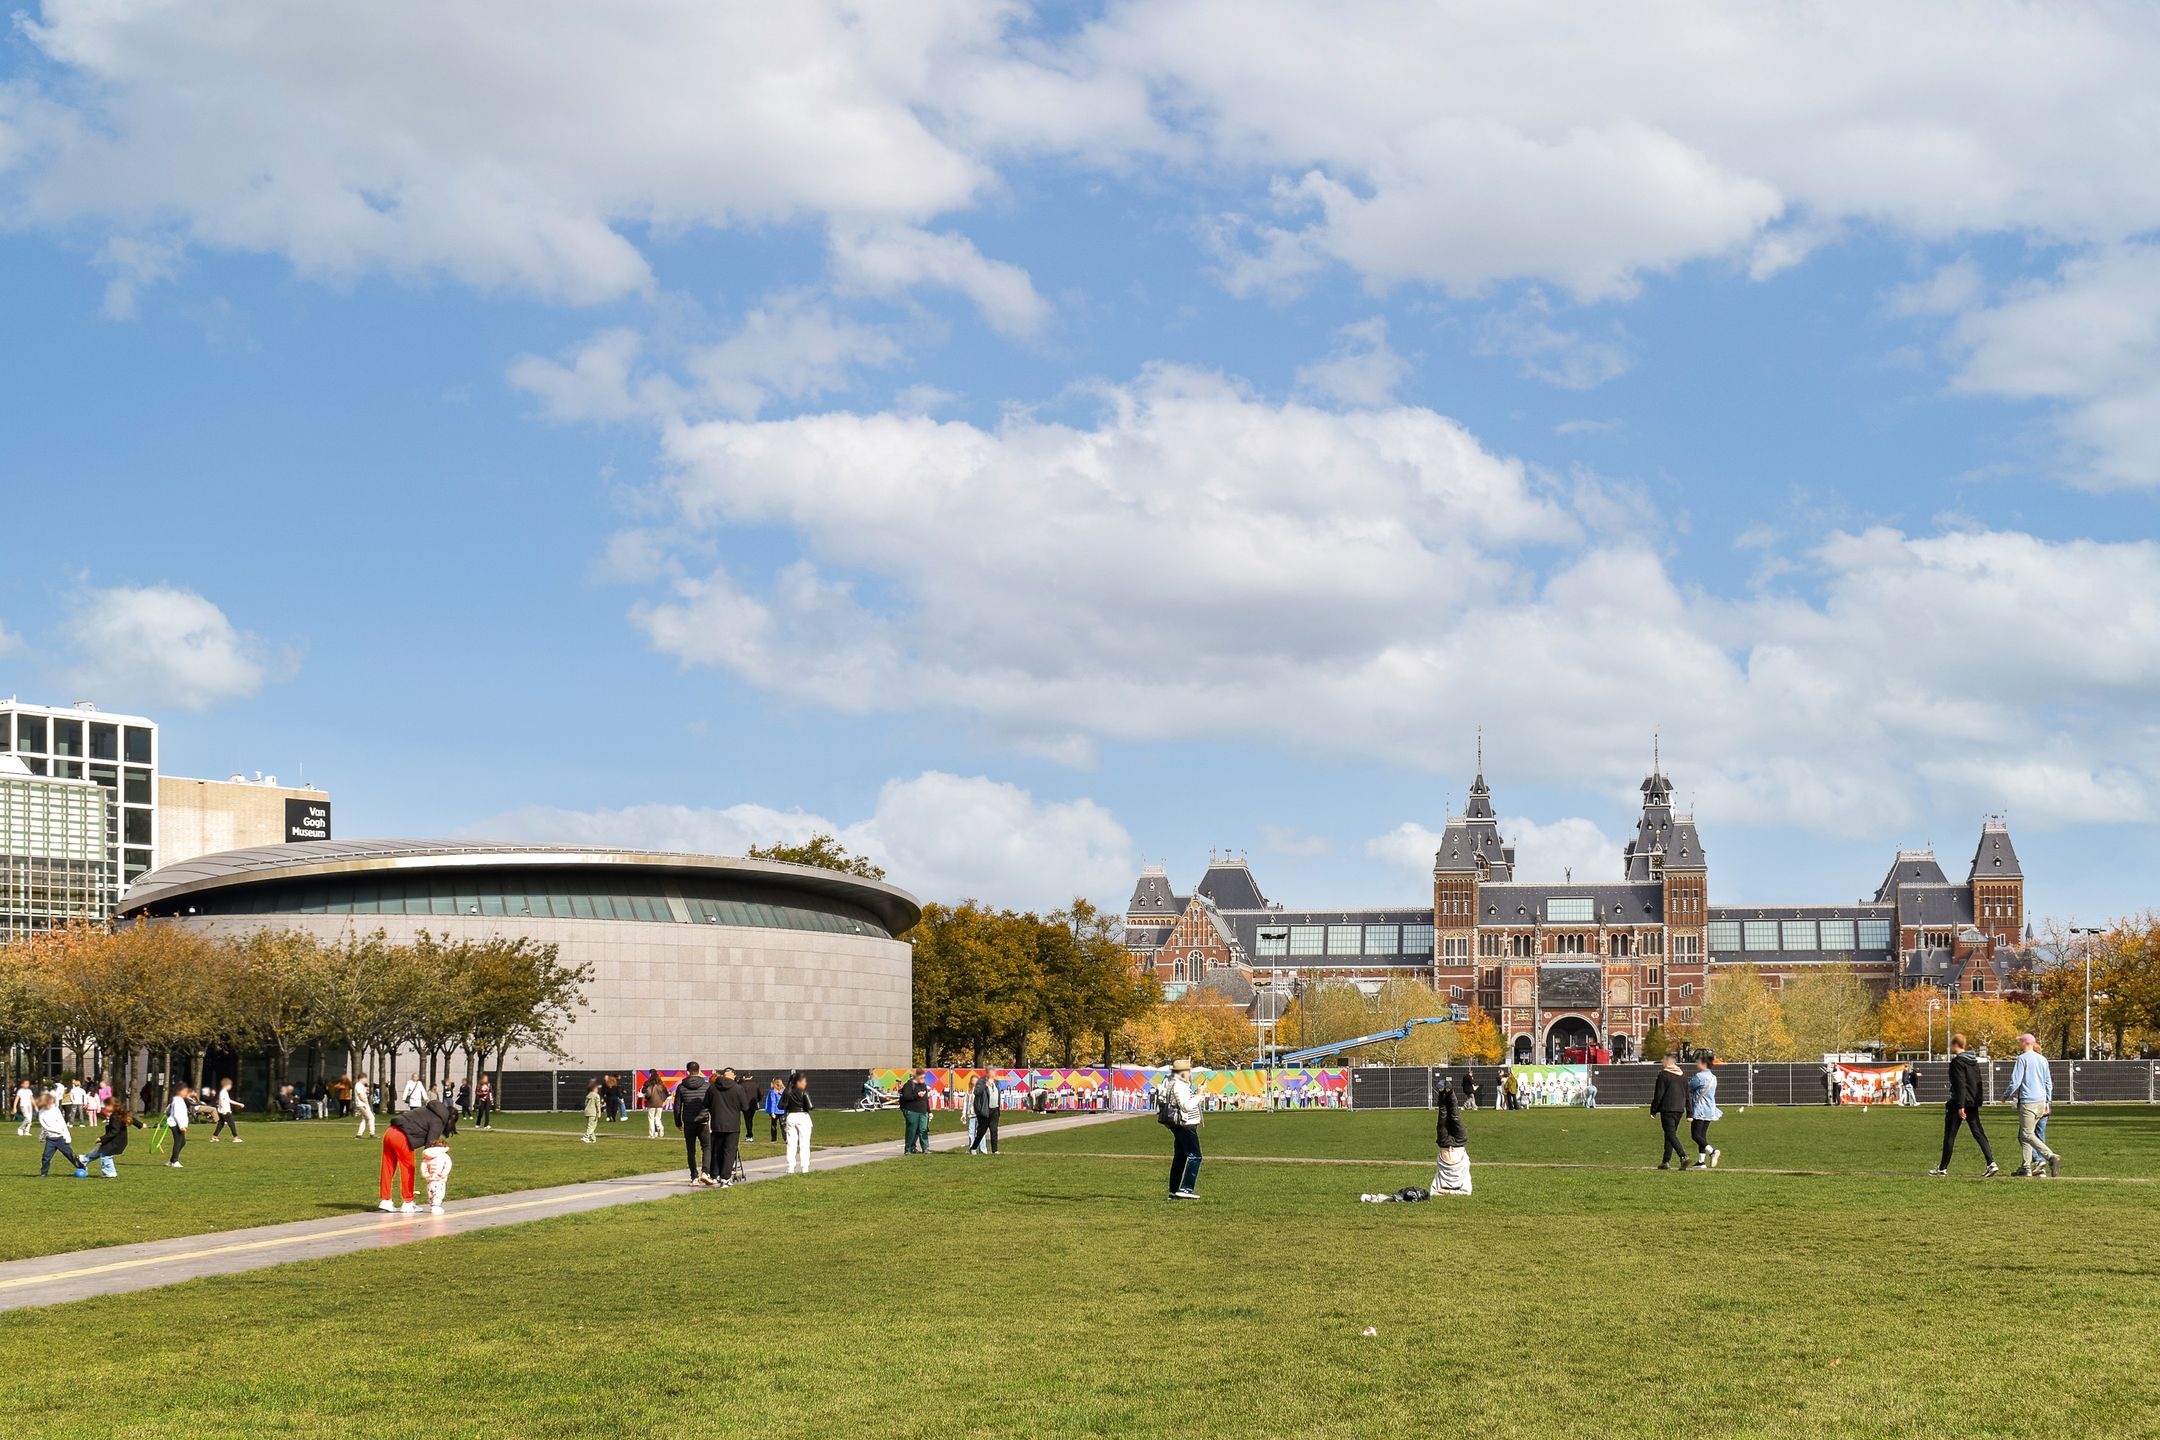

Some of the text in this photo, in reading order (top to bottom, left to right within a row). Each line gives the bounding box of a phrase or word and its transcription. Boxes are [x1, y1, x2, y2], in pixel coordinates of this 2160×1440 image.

[309, 806, 326, 817] Van
[303, 816, 326, 829] Gogh
[292, 826, 326, 838] Museum
